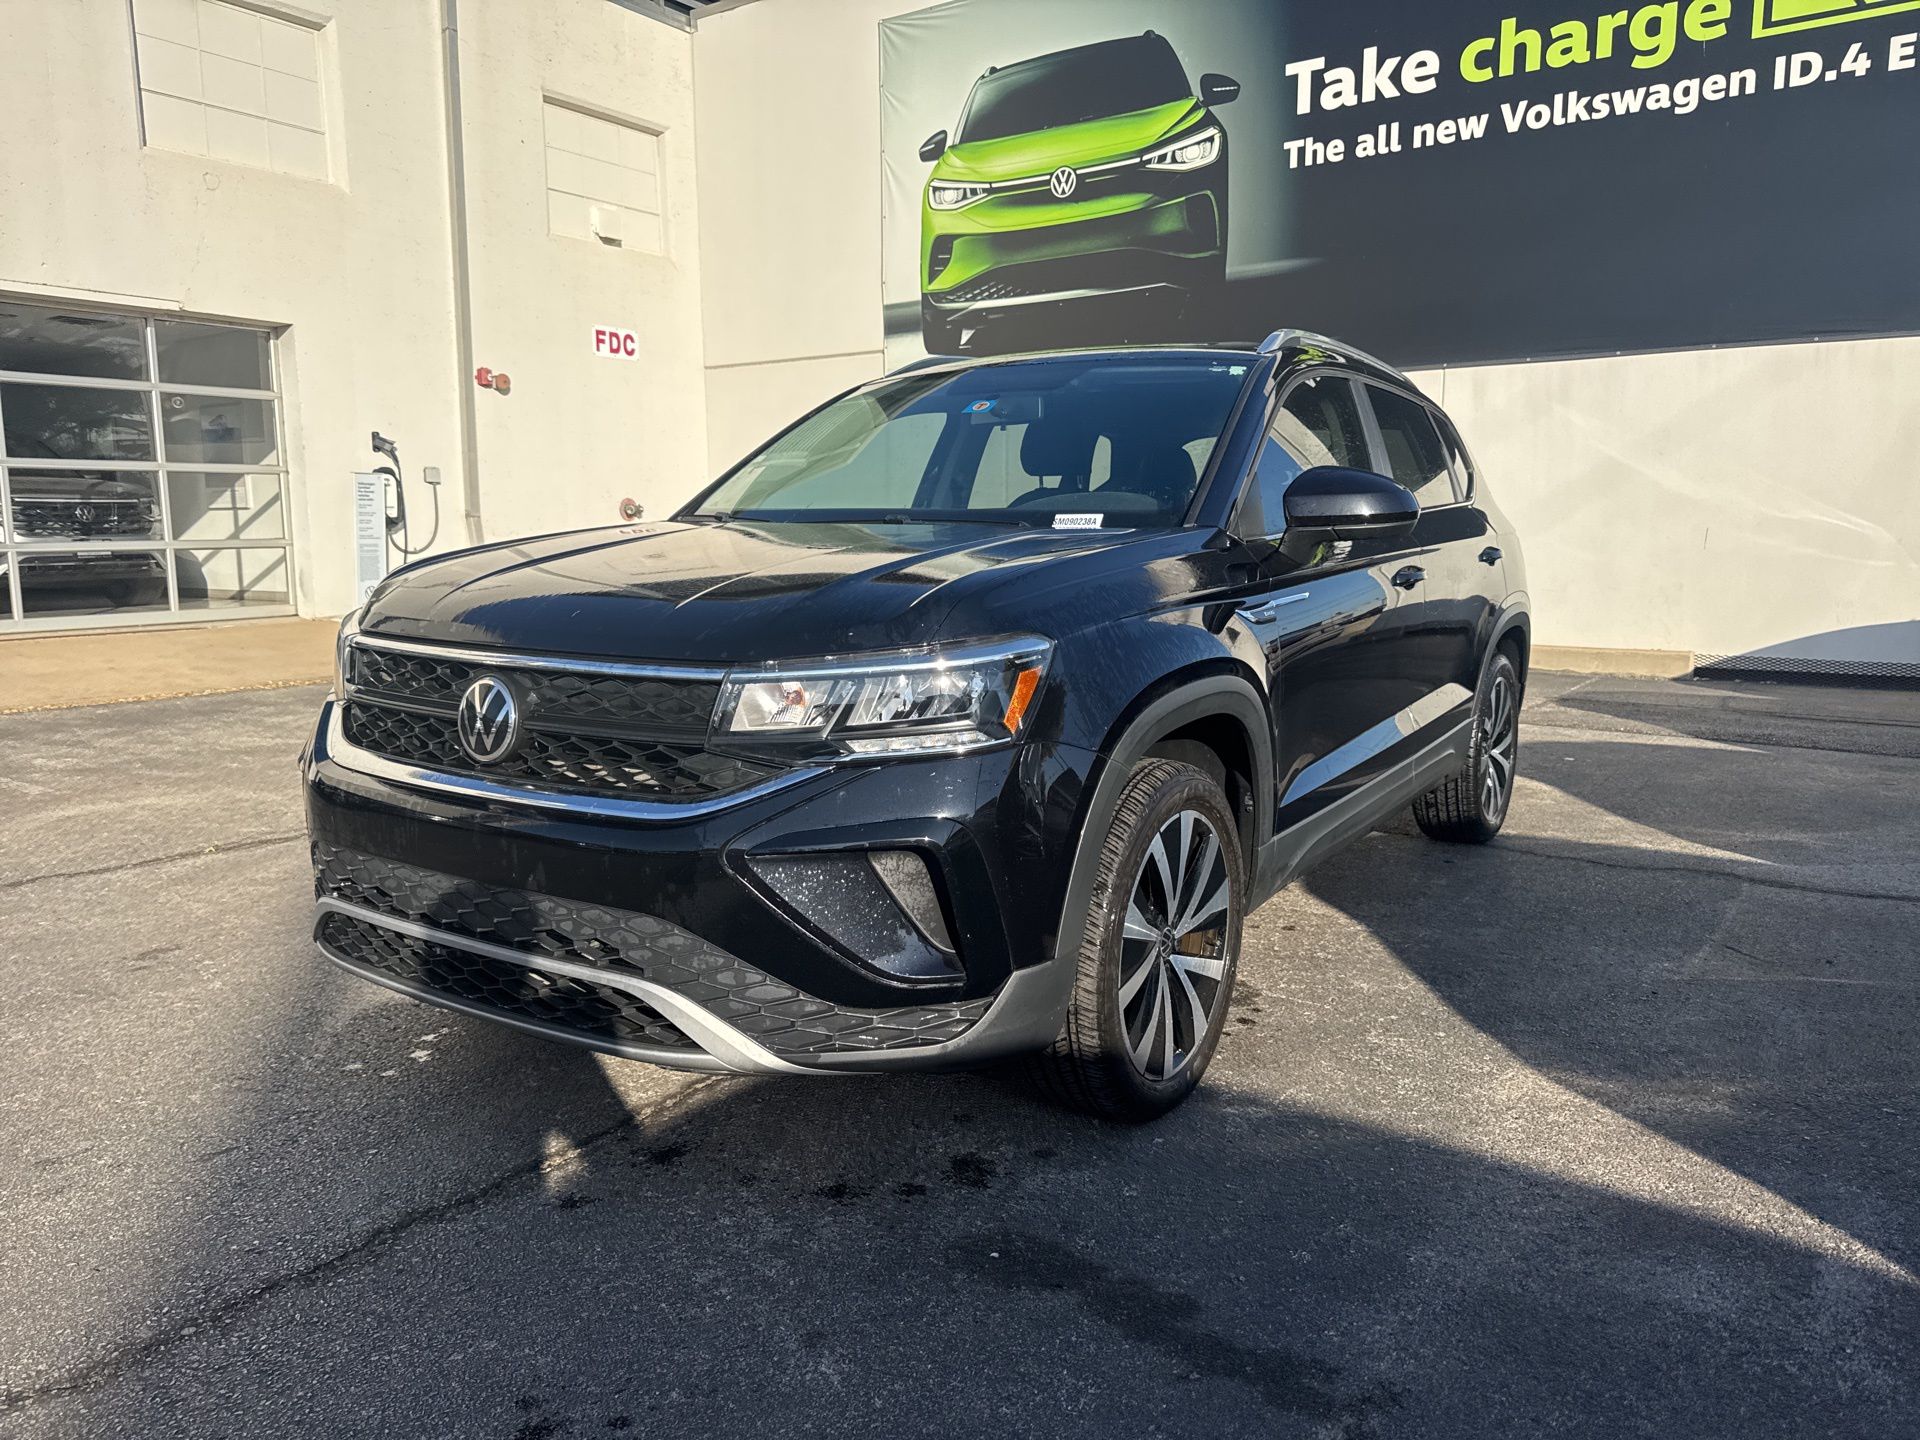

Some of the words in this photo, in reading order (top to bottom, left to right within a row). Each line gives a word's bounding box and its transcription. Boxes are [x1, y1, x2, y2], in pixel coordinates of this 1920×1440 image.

[1283, 137, 1345, 169] The
[1355, 121, 1402, 159] all
[1412, 113, 1490, 149] new
[1500, 68, 1757, 133] Volkswagen
[1773, 42, 1872, 91] ID.4
[1887, 32, 1920, 72] E
[1285, 46, 1440, 116] Take
[1459, 0, 1732, 83] charge
[1050, 166, 1077, 198] VW
[595, 329, 636, 357] FDC
[458, 675, 518, 762] VW
